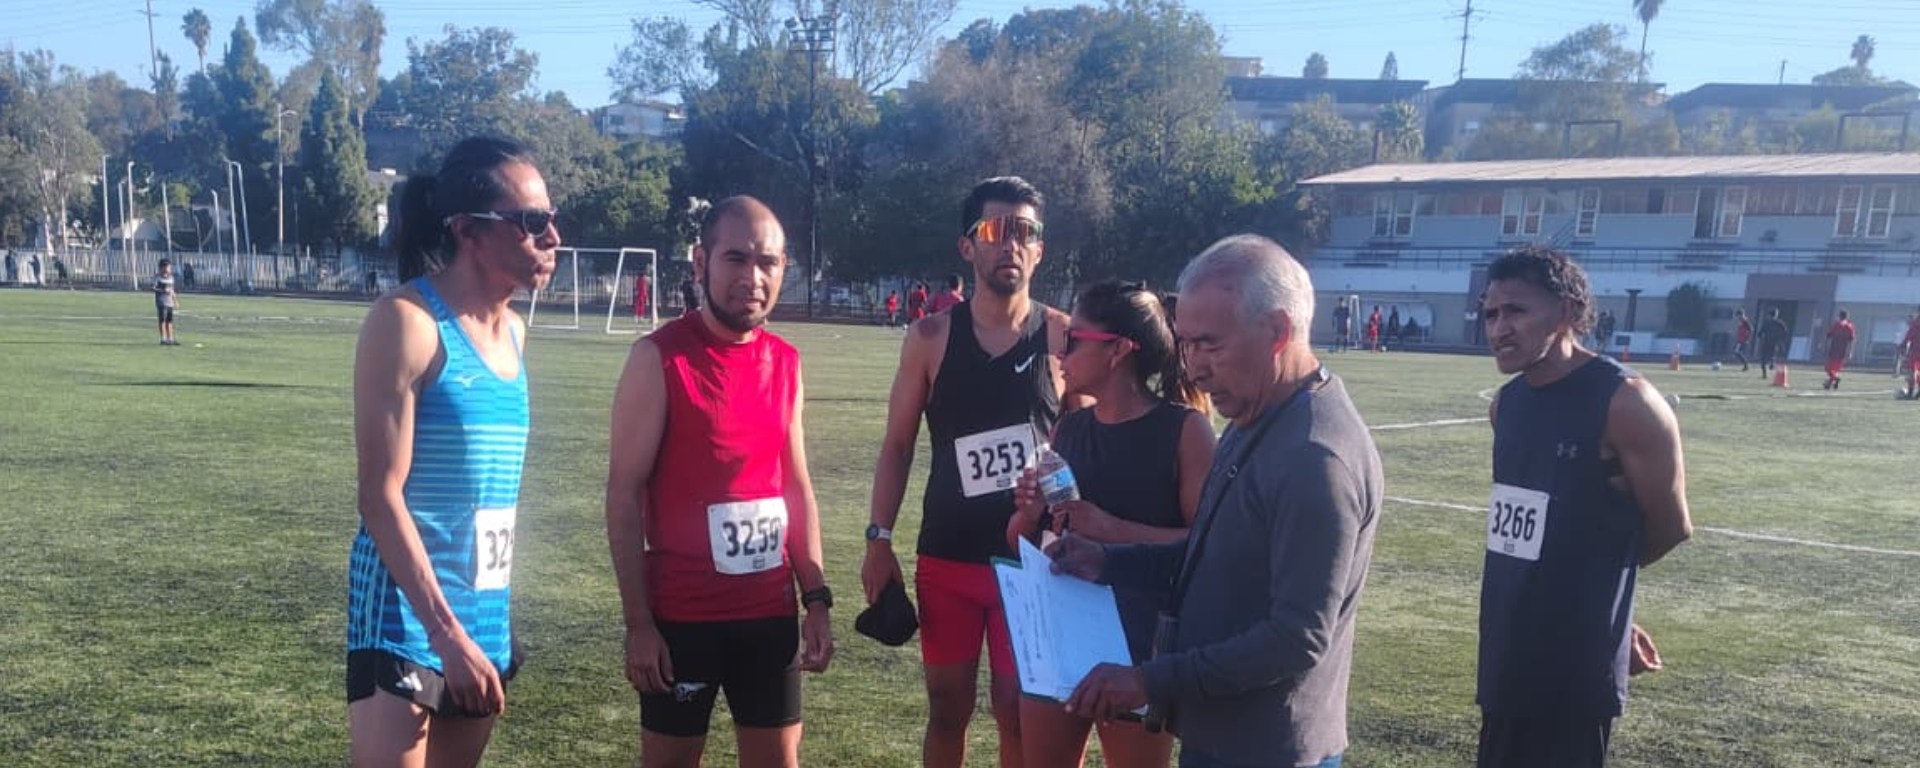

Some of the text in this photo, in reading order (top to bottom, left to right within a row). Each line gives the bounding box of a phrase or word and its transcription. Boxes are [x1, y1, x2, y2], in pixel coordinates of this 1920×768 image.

[967, 441, 1026, 480] 3253
[722, 516, 782, 557] 3259
[1492, 500, 1537, 542] 3266
[485, 528, 514, 571] 32
